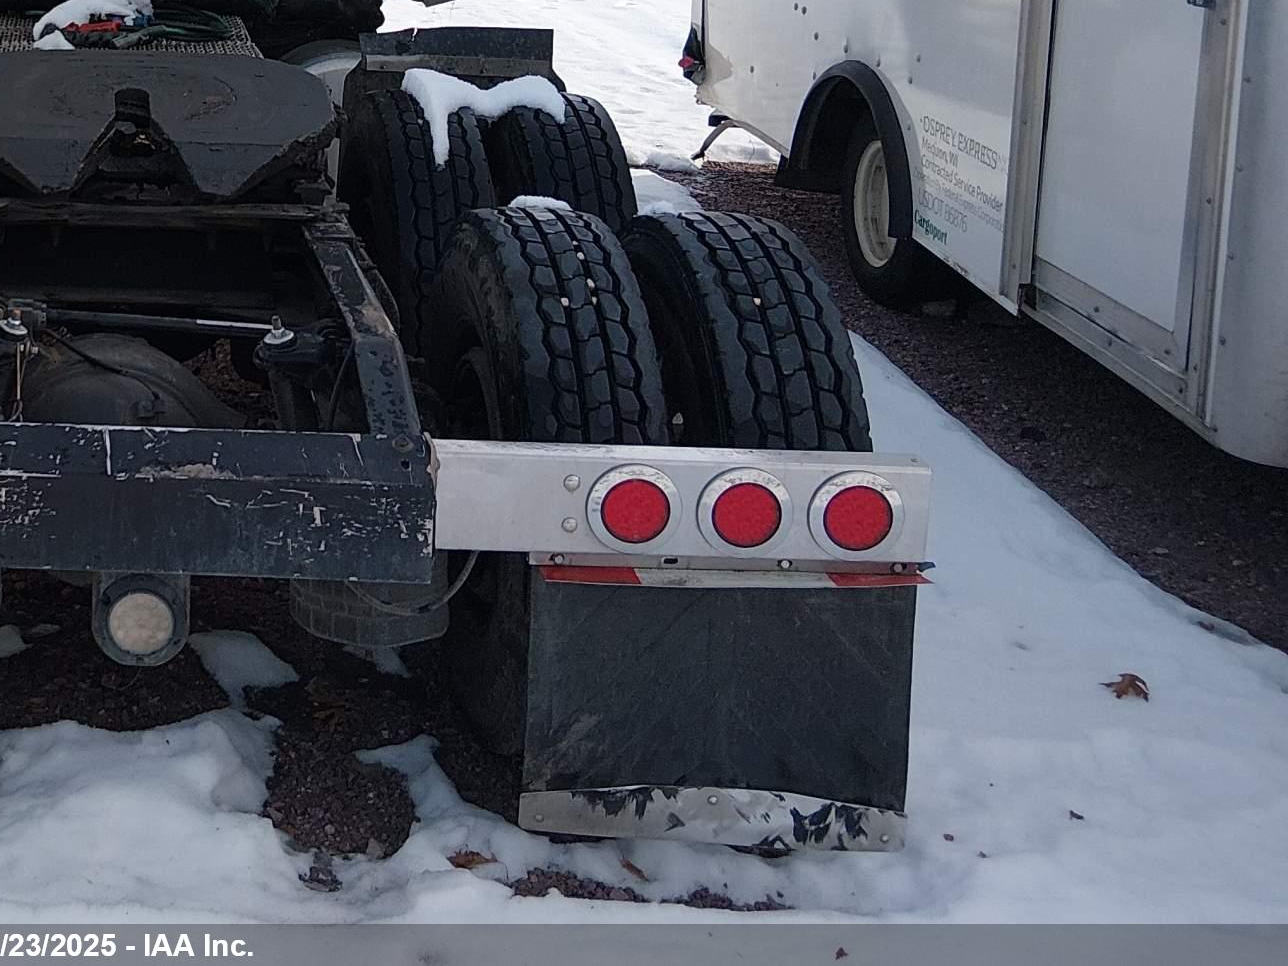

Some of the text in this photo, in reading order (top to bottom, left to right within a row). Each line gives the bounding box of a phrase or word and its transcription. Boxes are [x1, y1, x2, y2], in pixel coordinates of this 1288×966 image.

[923, 115, 956, 147] OSPREY
[958, 132, 998, 170] EXPRESS
[922, 153, 953, 183] Contracted
[953, 173, 976, 198] Service
[976, 185, 1003, 212] Provider
[914, 209, 948, 246] Cargoport
